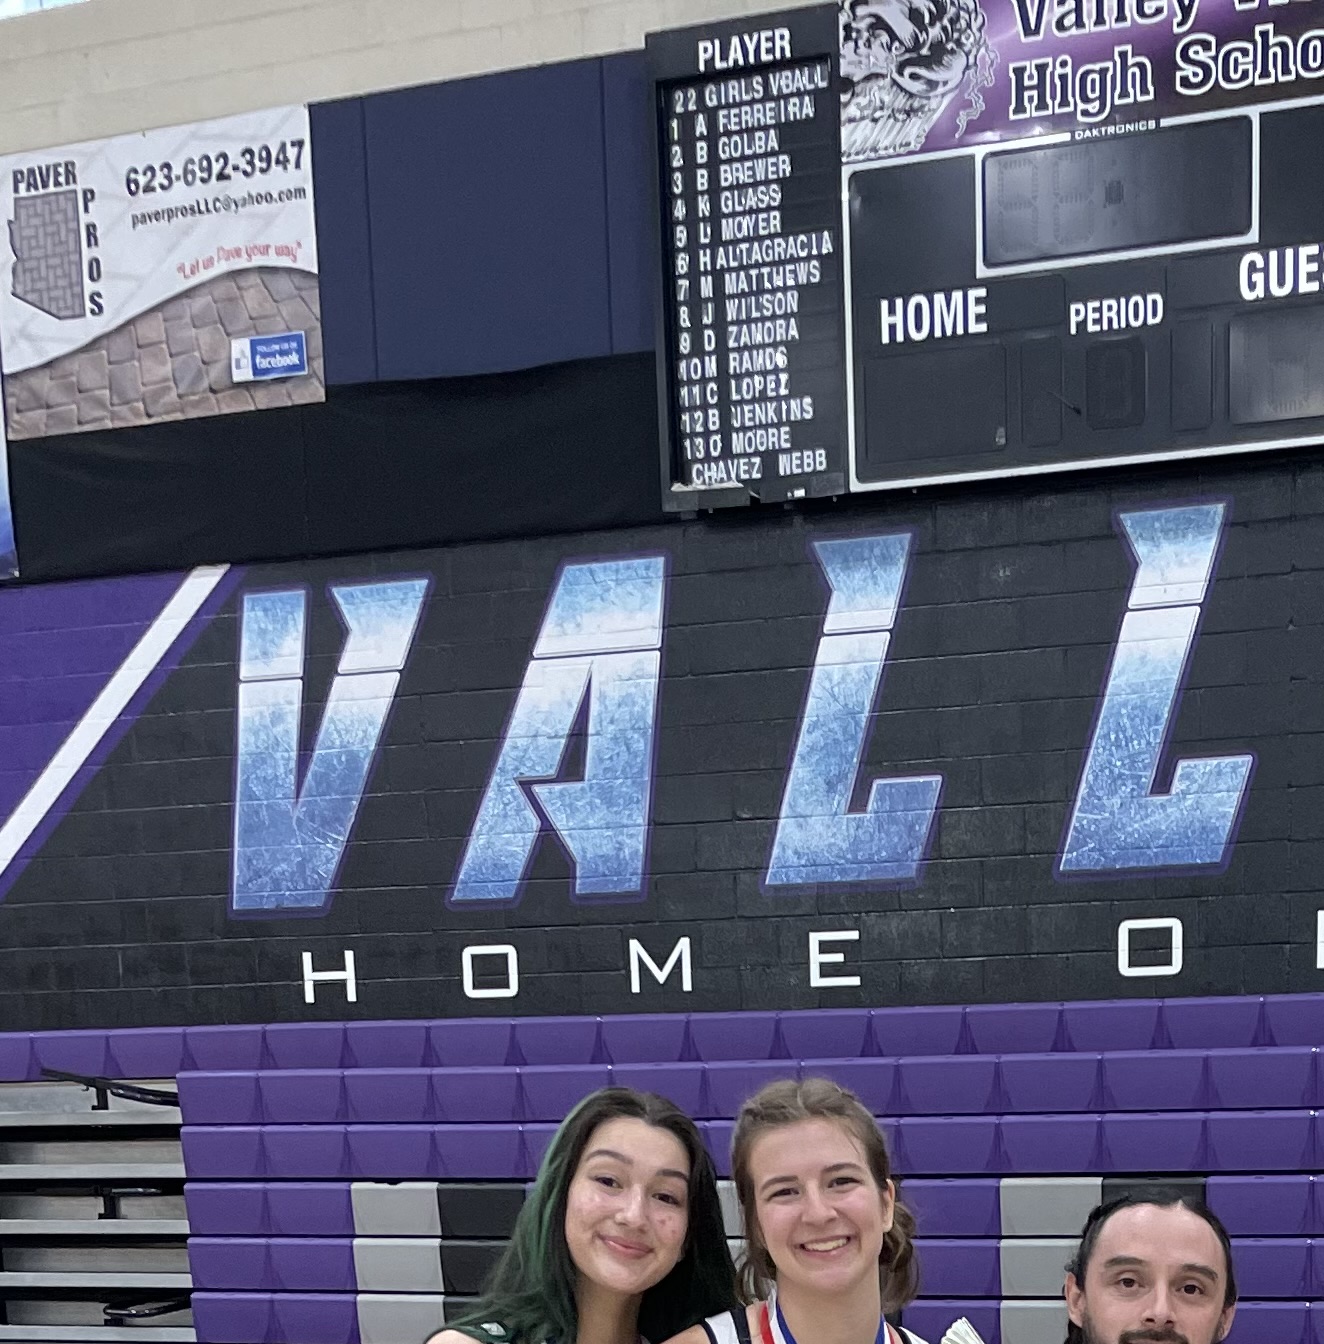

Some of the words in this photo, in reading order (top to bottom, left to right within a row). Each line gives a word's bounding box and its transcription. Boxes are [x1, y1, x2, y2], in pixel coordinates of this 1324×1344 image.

[698, 27, 791, 73] PLAYER
[674, 88, 697, 113] 22
[705, 75, 764, 108] GIRLS
[768, 63, 829, 97] VBALL
[1009, 44, 1154, 122] High
[671, 118, 679, 140] 1
[695, 113, 708, 138] A
[718, 95, 815, 133] FERREIRA
[1074, 118, 1156, 141] DAKTRONICS
[125, 139, 306, 197] 623-692-3947
[671, 146, 683, 168] 2
[696, 140, 708, 165] B
[718, 128, 779, 160] GOLBA
[12, 160, 77, 194] PAVER
[672, 171, 682, 195] 3
[696, 168, 708, 192] B
[720, 154, 792, 187] BREWER
[673, 199, 685, 221] 4
[698, 195, 710, 218] K
[720, 184, 781, 214] GLASS
[675, 225, 687, 248] 5
[699, 222, 710, 244] L
[721, 211, 781, 242] MOYER
[82, 188, 104, 317] PROS
[676, 253, 689, 275] 6
[699, 248, 711, 271] H
[716, 229, 833, 270] ALTAGRACIA
[676, 279, 689, 301] 7
[701, 275, 713, 298] M
[680, 305, 691, 328] 8
[702, 302, 713, 325] J
[725, 290, 799, 321] WILSON
[880, 287, 988, 345] HOME
[1070, 293, 1164, 336] PERIOD
[680, 332, 691, 354] 9
[704, 329, 716, 352] D
[727, 317, 800, 349] ZAMORA
[730, 372, 790, 401] LOPEZ
[732, 426, 791, 455] MOORE
[692, 456, 762, 486] CHAVEZ
[778, 448, 827, 476] WEBB
[302, 928, 862, 1005] HOME
